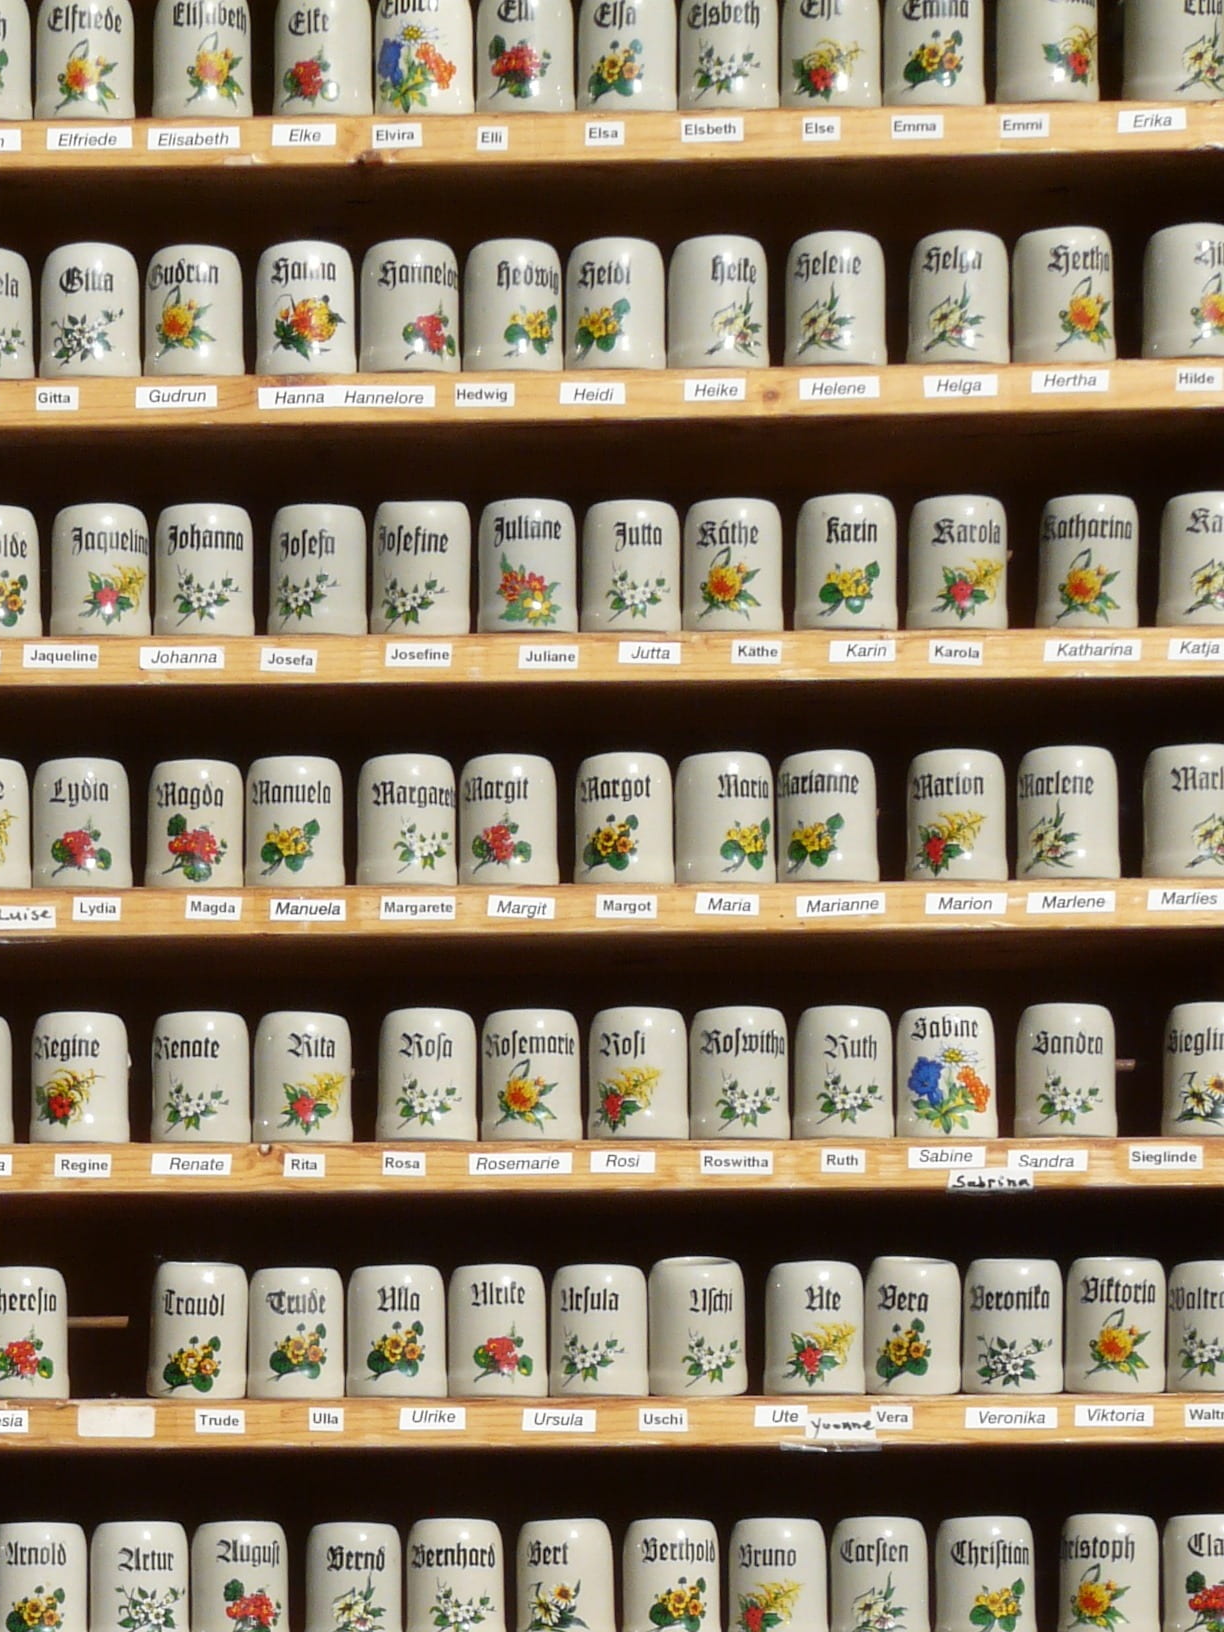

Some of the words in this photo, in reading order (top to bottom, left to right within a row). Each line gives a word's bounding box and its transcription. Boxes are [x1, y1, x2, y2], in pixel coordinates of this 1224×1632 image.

[684, 123, 736, 136] Elsbeth
[893, 120, 937, 132] Emma
[288, 129, 321, 142] Elke
[376, 130, 415, 141] Elvira
[811, 383, 865, 395] Helene
[937, 379, 982, 395] Helga
[148, 389, 207, 403] Gudrun
[456, 388, 508, 402] Hedwig
[151, 650, 217, 664] Johanna
[391, 648, 450, 660] Josefine
[631, 646, 670, 660] Jutta
[275, 901, 341, 916] Manuela
[707, 897, 751, 912] Maria
[61, 1159, 108, 1173] Regine
[385, 1156, 420, 1169] Rosa
[476, 1157, 560, 1170] Rosemarie
[704, 1155, 769, 1168] Roswitha
[952, 1175, 1031, 1189] Sabrina
[199, 1414, 240, 1427] Trude
[412, 1410, 456, 1424] Ulrike
[534, 1412, 583, 1426] Ursula
[979, 1411, 1046, 1424] Veronika
[1087, 1407, 1145, 1422] Viktoria
